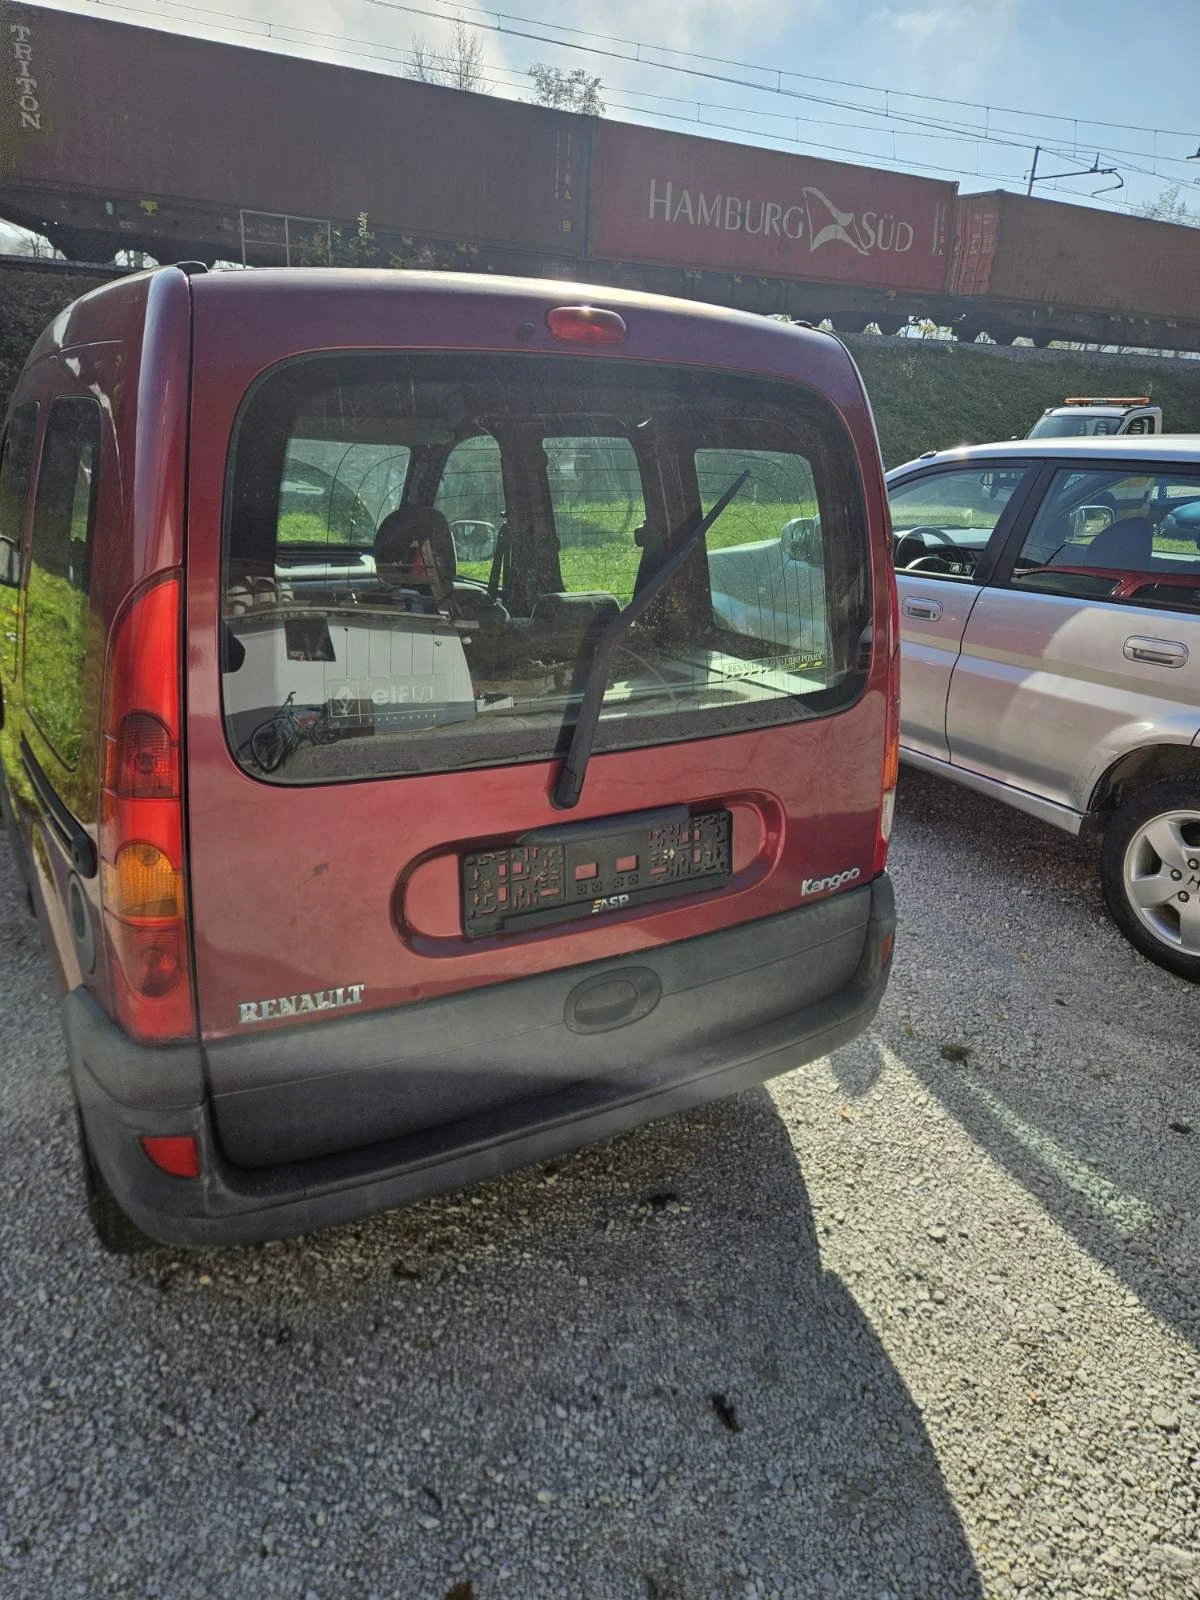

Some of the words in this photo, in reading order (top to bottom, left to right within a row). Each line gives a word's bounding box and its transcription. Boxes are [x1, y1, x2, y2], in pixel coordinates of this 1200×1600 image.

[10, 25, 41, 129] TRITON
[649, 178, 804, 240] HAMBURG
[862, 211, 915, 252] SÜD
[371, 685, 409, 706] elf
[800, 867, 861, 897] Kangoo
[237, 984, 365, 1024] RENAULT
